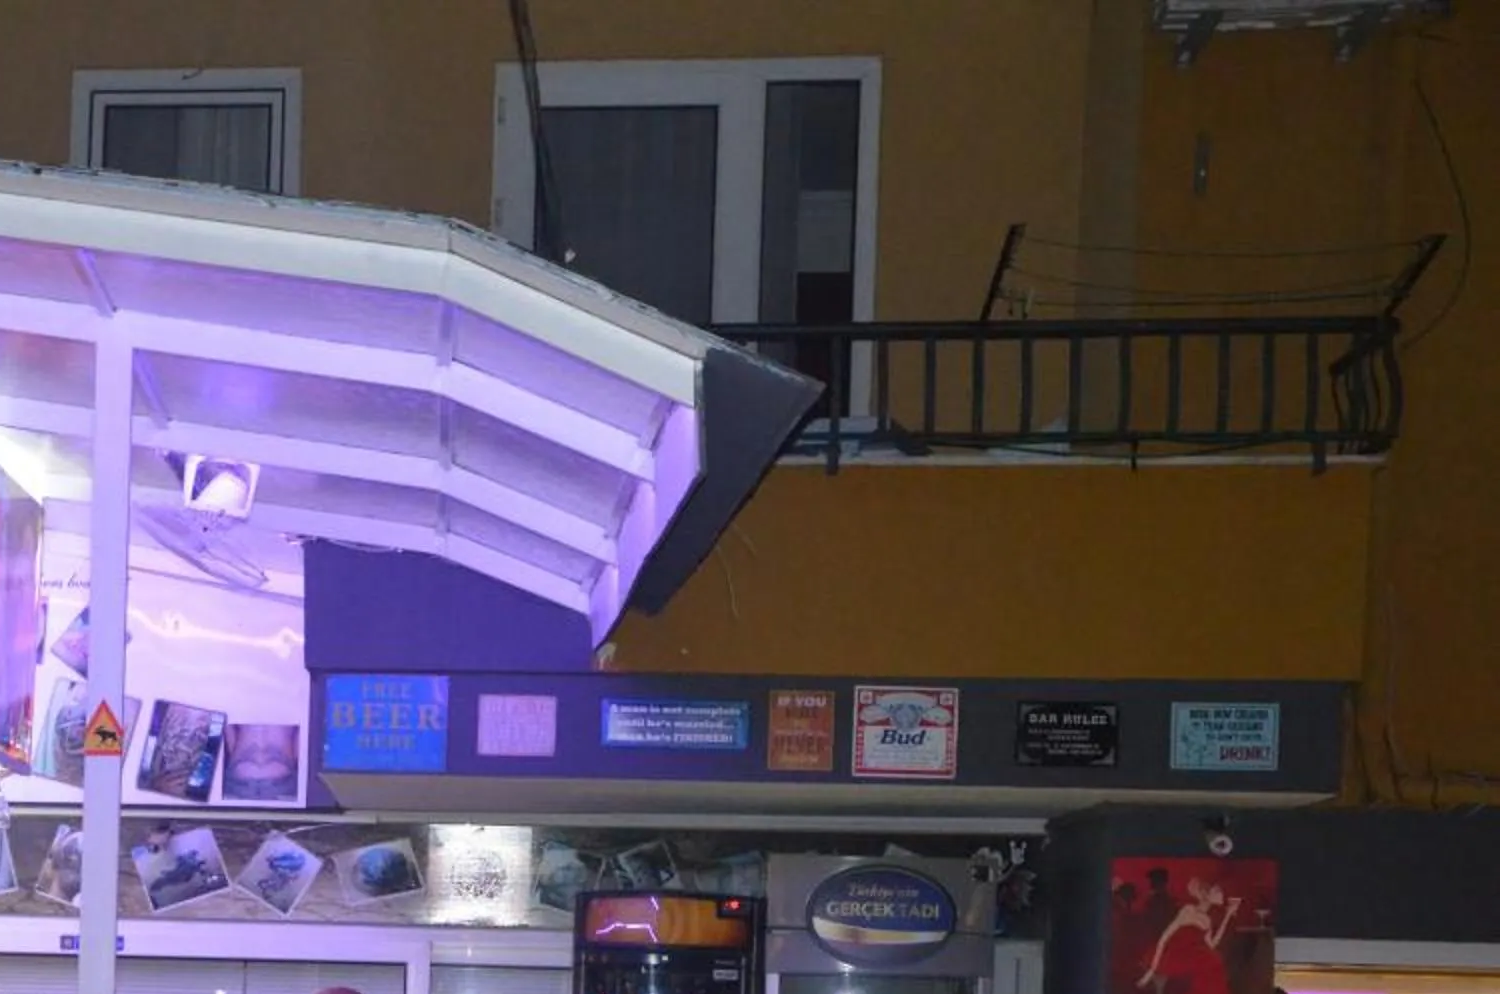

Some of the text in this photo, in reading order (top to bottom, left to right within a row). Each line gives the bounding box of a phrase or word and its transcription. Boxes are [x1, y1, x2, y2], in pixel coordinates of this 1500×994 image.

[794, 695, 827, 707] YOU
[332, 701, 445, 731] BEER
[1028, 713, 1058, 724] BAR
[880, 728, 926, 745] Bud
[826, 901, 895, 921] GERÇEK
